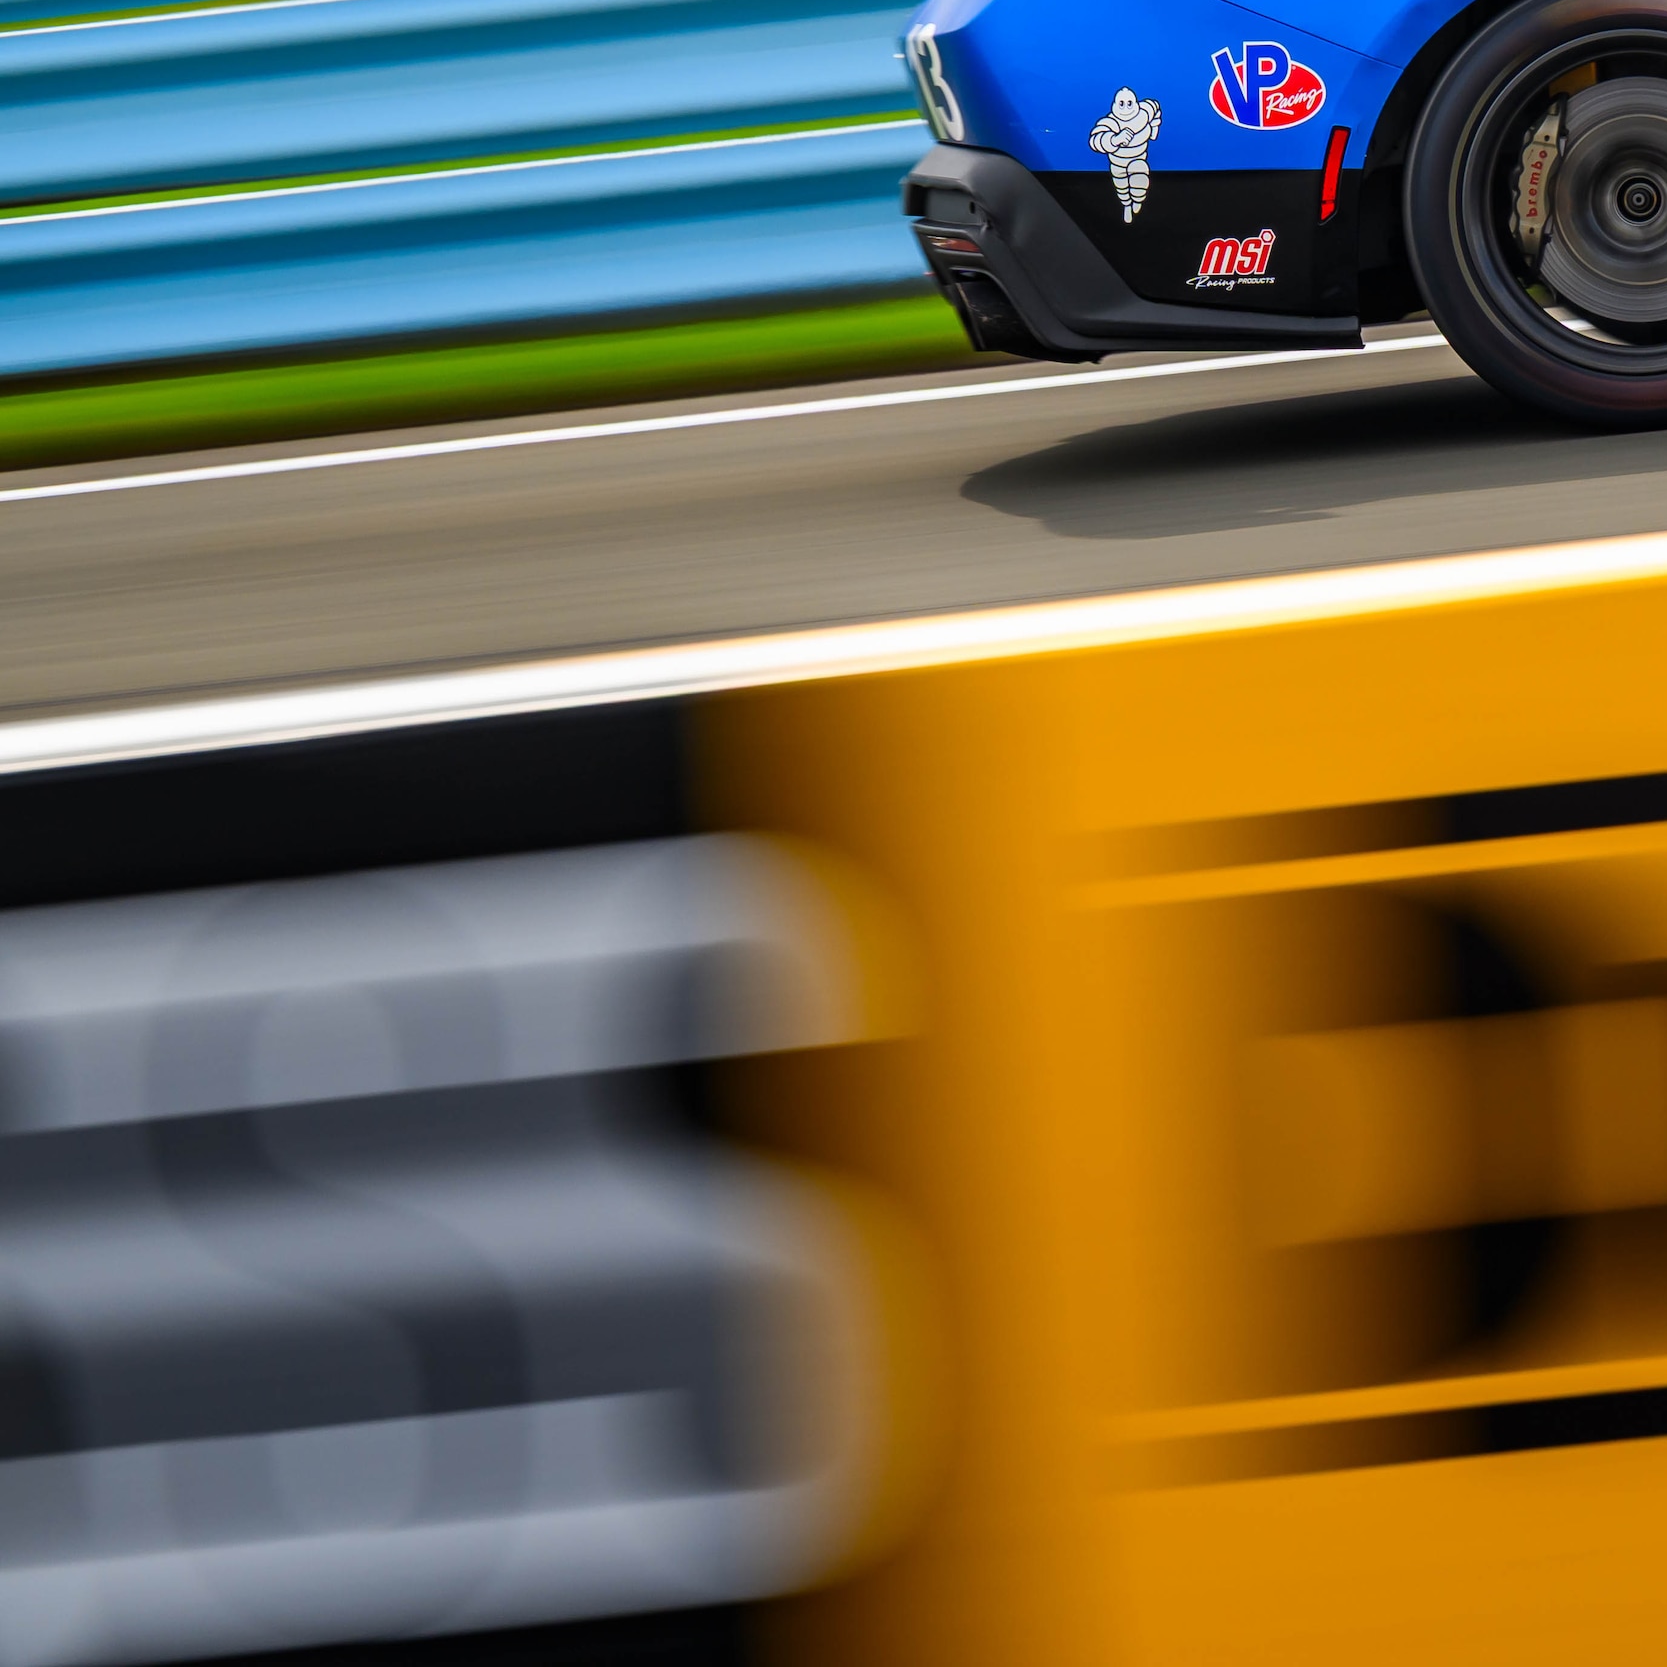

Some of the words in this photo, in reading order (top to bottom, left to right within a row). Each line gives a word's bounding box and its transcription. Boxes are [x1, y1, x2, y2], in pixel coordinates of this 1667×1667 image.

[1211, 41, 1291, 129] VP
[1265, 87, 1323, 119] Racing
[1526, 149, 1548, 217] brembo
[1198, 229, 1276, 275] msi
[1186, 275, 1237, 291] Racing
[1237, 277, 1276, 285] PRODUCTS
